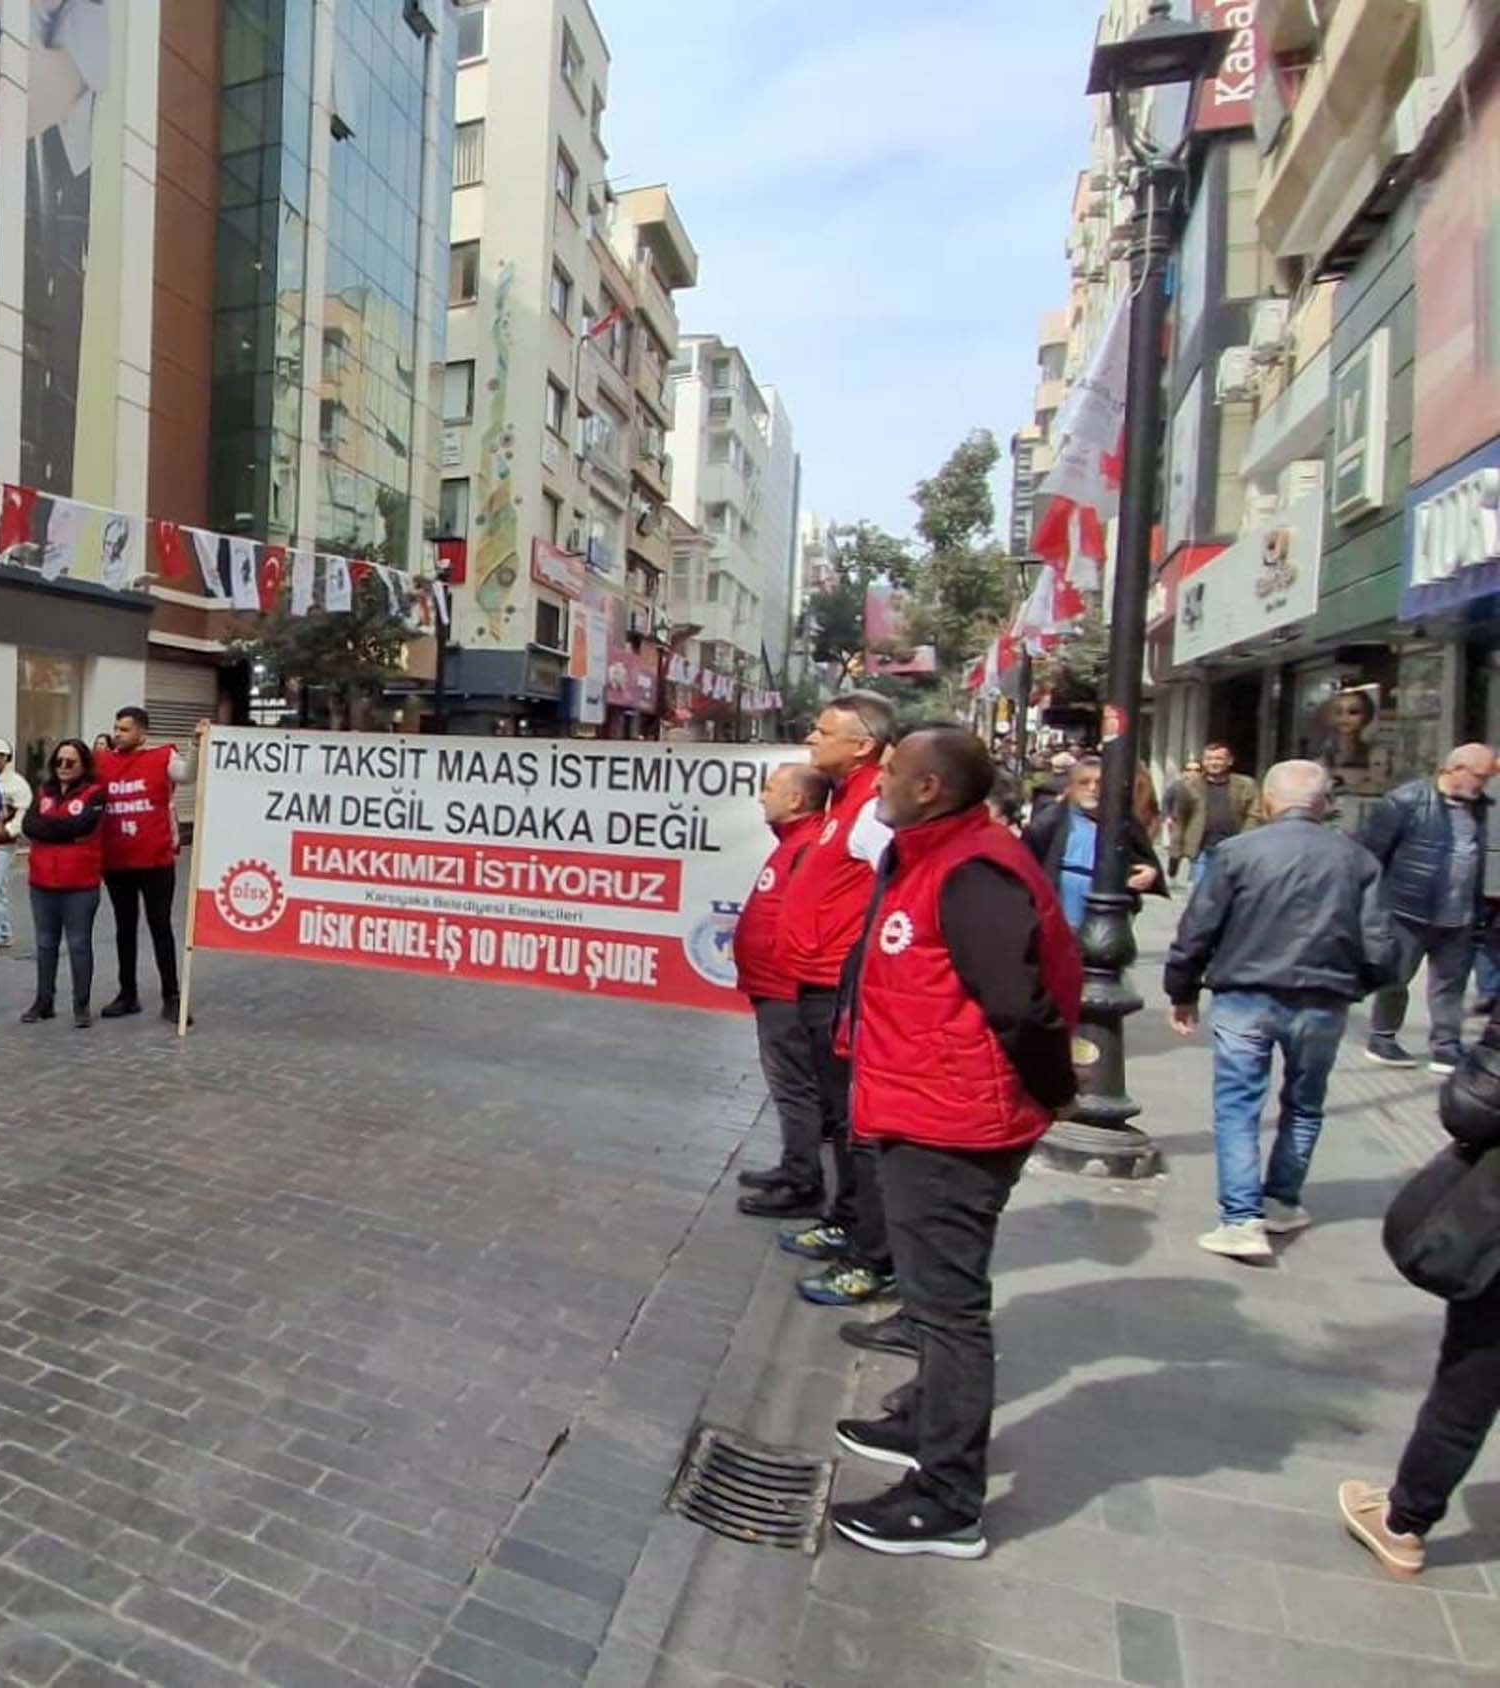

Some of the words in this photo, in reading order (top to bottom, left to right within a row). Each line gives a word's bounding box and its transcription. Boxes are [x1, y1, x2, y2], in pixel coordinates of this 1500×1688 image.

[1214, 0, 1257, 106] Kasa
[211, 735, 311, 775] TAKSİT
[320, 738, 428, 781] TAKSİT
[437, 749, 539, 796] MAAŞ
[265, 790, 332, 825] ZAM
[340, 787, 434, 833] DEĞİL
[444, 801, 594, 844] SADAKA
[607, 802, 722, 852] DEĞİL
[232, 882, 270, 902] DİSK
[302, 846, 465, 886] HAKKIMIZI
[474, 851, 666, 904] İSTİYORUZ
[299, 905, 356, 951] DİSK
[359, 915, 463, 973] GENEL-İŞ
[468, 926, 498, 968] 10
[583, 938, 660, 990] ŞUBE
